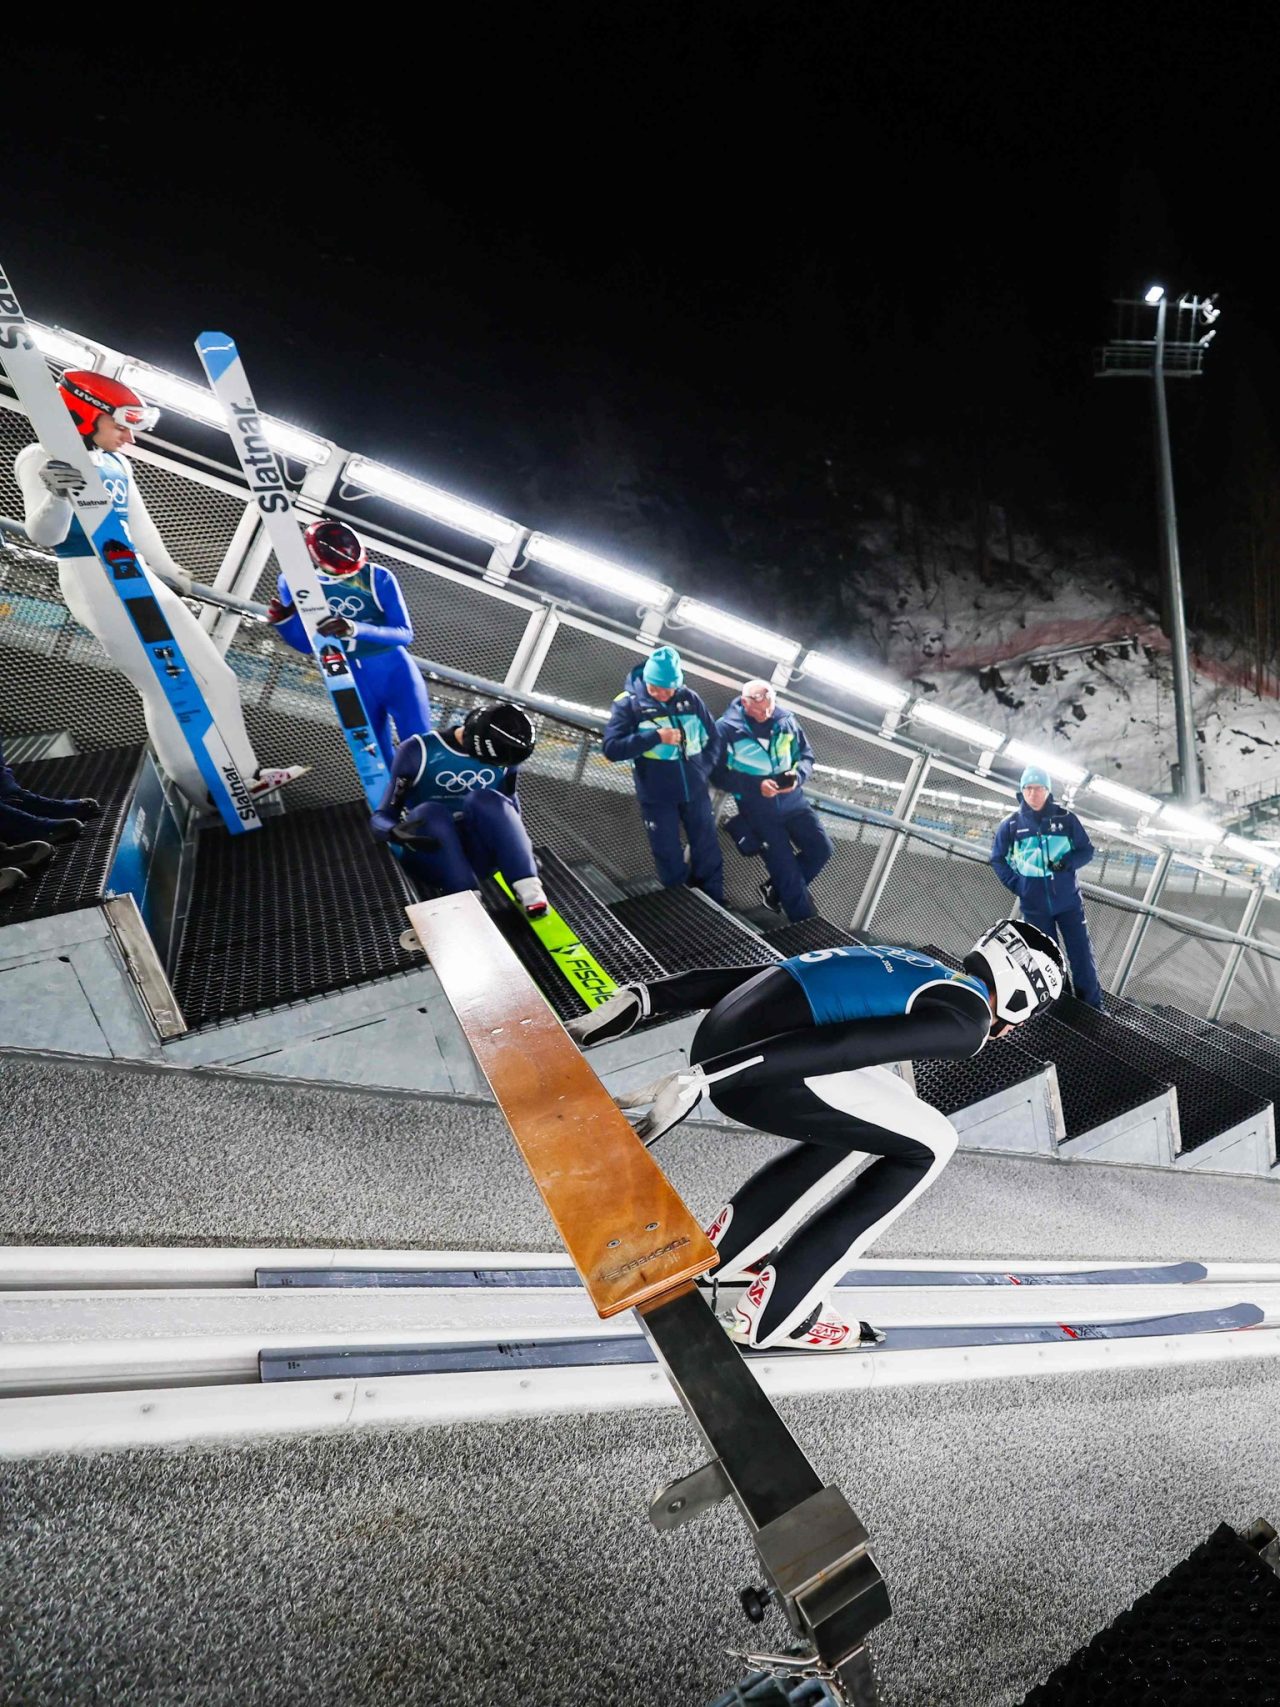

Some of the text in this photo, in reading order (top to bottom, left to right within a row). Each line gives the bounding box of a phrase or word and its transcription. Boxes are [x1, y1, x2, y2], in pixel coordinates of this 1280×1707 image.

[74, 389, 110, 412] uvex
[230, 402, 289, 513] Slatnar
[221, 765, 256, 821] Slatnar
